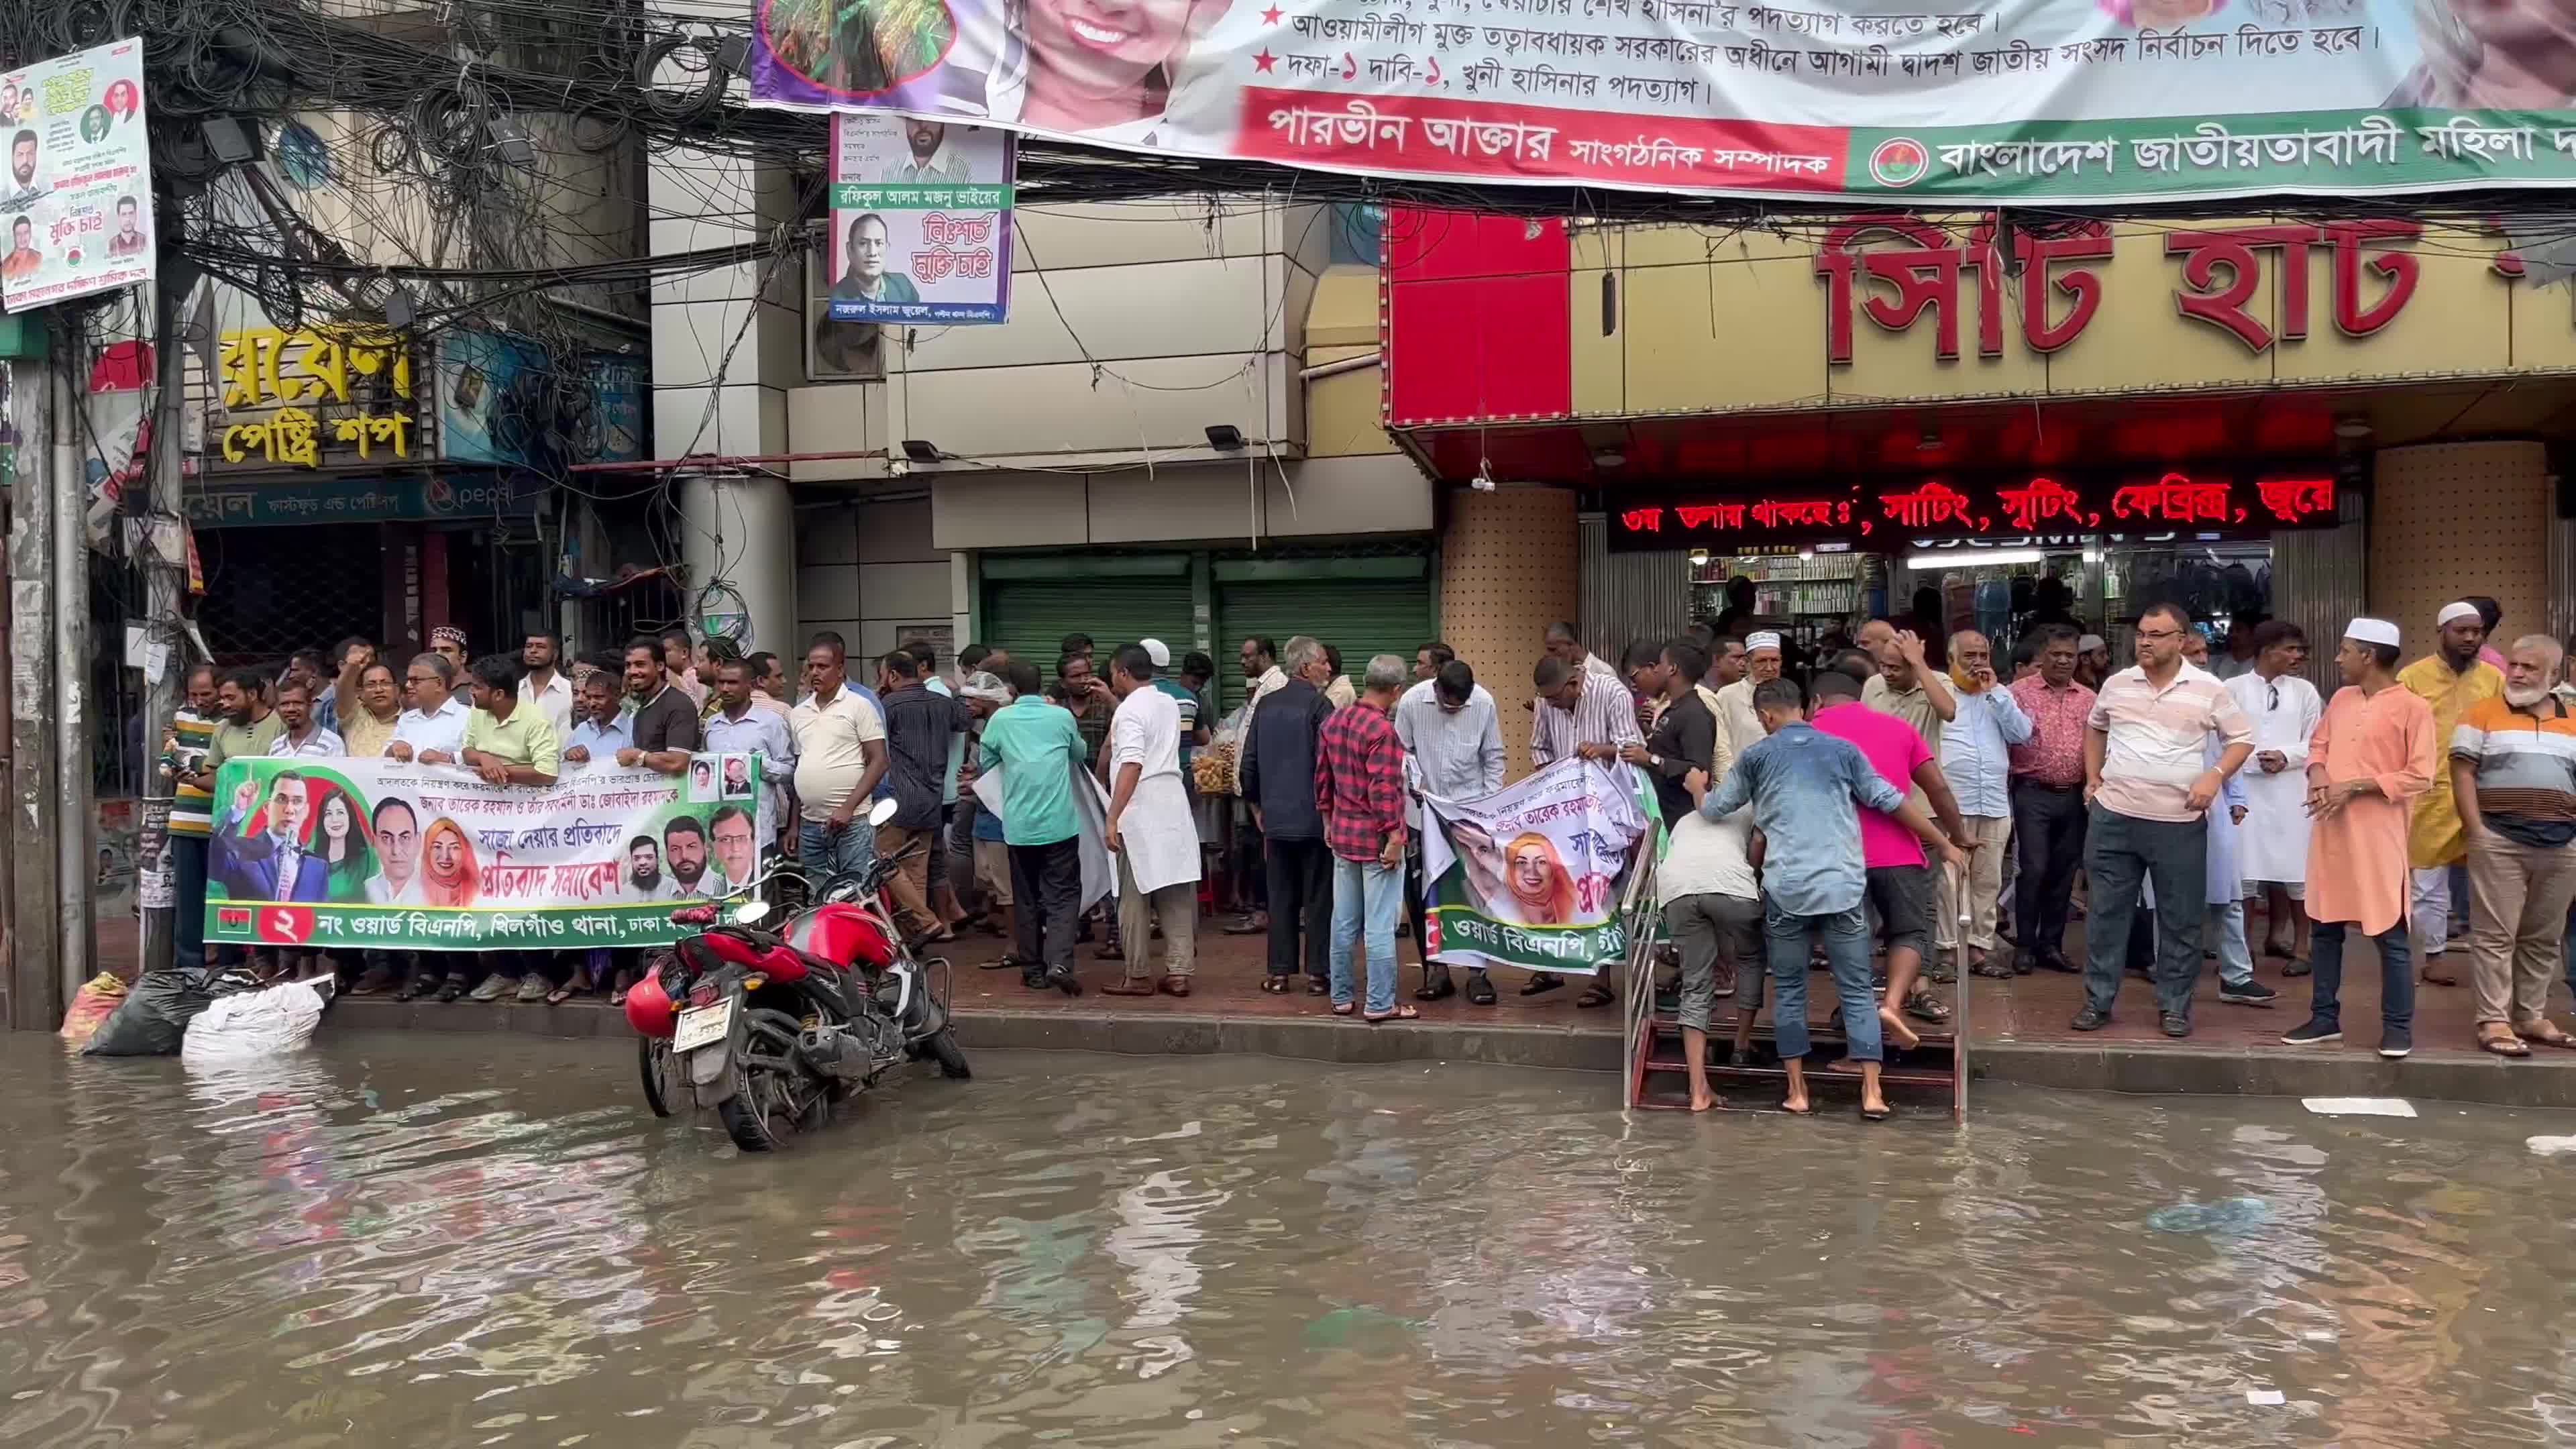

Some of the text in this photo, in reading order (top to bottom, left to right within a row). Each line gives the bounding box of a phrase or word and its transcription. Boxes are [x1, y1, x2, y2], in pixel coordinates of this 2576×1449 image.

[1748, 5, 1843, 35] পদত্যাগ
[1850, 15, 1927, 37] করতে
[1291, 13, 1428, 44] আওয়ামীলীগ
[1433, 23, 1476, 52] মুক্ত
[1615, 36, 1718, 65] সরকারের
[1723, 38, 1800, 73] অধীনে
[1807, 43, 1893, 77] আগামী
[1900, 50, 1964, 78] দ্বাদশ
[1970, 39, 2052, 76] জাতীয়
[2059, 38, 2129, 65] সংসদ
[2135, 25, 2229, 60] নির্বাচন
[2235, 23, 2303, 57] দিতে
[1286, 51, 1358, 81] দফা-১
[1463, 56, 1503, 93] খুনী
[1511, 59, 1600, 97] হাসিনার
[1268, 100, 1832, 175] পারভীন আক্তার সাংগঠনিক সম্পাদক
[1936, 115, 2576, 178] বাংলাদেশ জাতীয়তাবাদী মহিলা দ
[839, 185, 1002, 209] রফিকুল আলম মজনু ভাইয়ের
[50, 211, 103, 246] মুক্তি চাই
[922, 211, 999, 245] নিঃশর্ত
[910, 244, 994, 284] মুক্তি চাই
[1812, 208, 2117, 366] সিটি
[2163, 216, 2425, 356] হাট
[868, 301, 901, 317] ইসলাম
[330, 410, 413, 461] শপ
[460, 486, 515, 508] pepi
[419, 795, 446, 814] জনাব
[447, 796, 481, 814] তারেক
[482, 799, 514, 817] রহমান
[516, 799, 526, 815] ও
[579, 793, 596, 809] ডাঃ
[1523, 803, 1560, 825] তারেক
[1560, 795, 1587, 818] রহমা
[478, 816, 624, 851] সাজা দেয়ার প্রতিবাদে
[480, 850, 623, 901] প্রতিবাদ সমাবেশ
[273, 909, 299, 943] ২
[317, 913, 345, 936] নং
[350, 910, 407, 936] ওয়ার্ড
[408, 911, 482, 942] বিএনপি,
[490, 912, 566, 938] খিলগাঁও
[627, 914, 661, 933] ঢাকা
[1452, 919, 1499, 946] ওয়ার্ড
